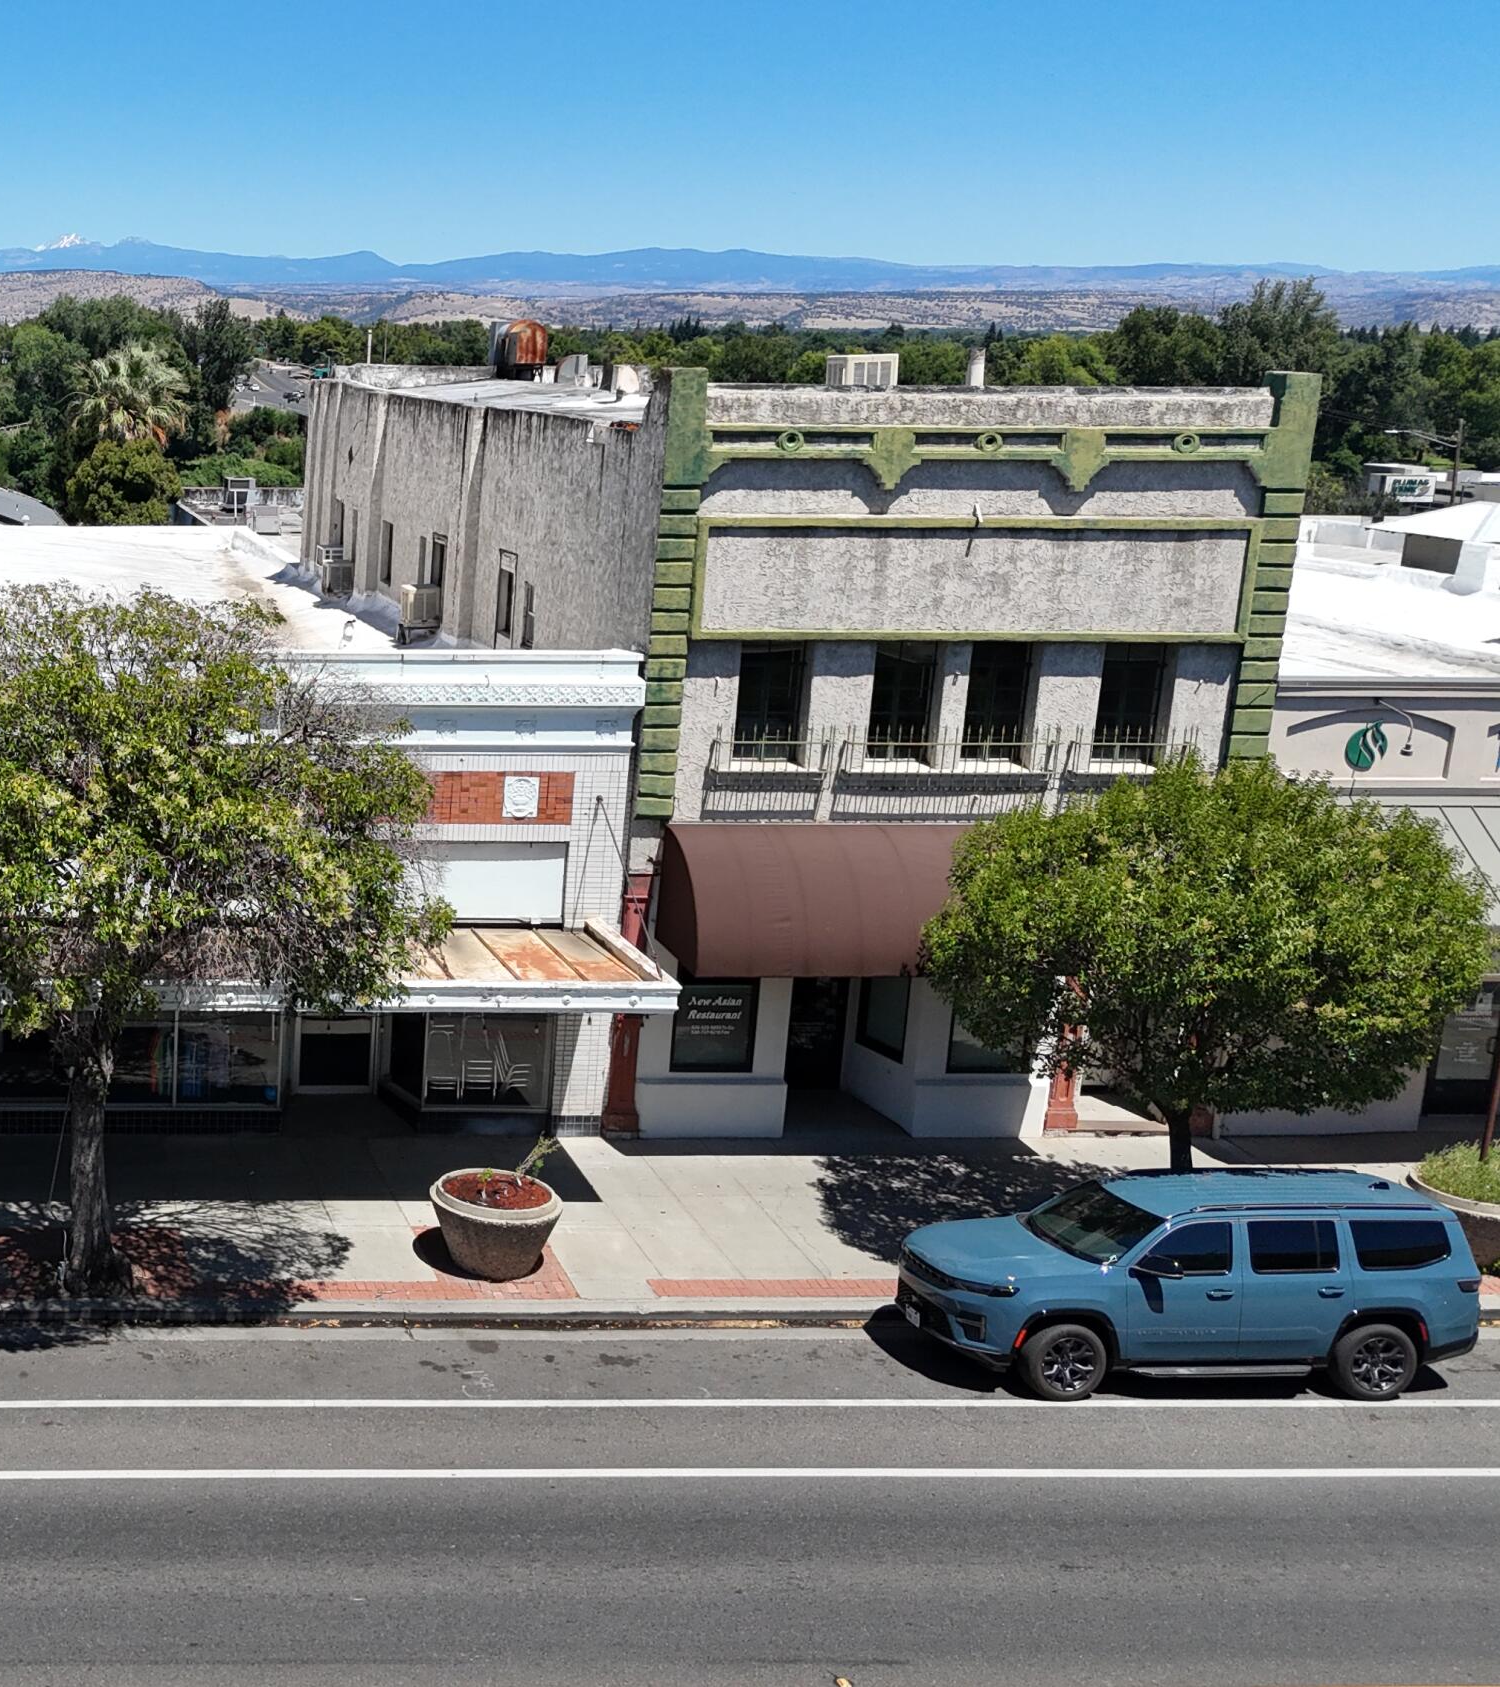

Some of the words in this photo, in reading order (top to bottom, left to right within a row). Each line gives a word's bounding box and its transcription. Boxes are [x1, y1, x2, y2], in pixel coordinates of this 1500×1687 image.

[688, 996, 712, 1006] New
[712, 996, 742, 1006] Asian
[687, 1009, 742, 1019] Restaurant
